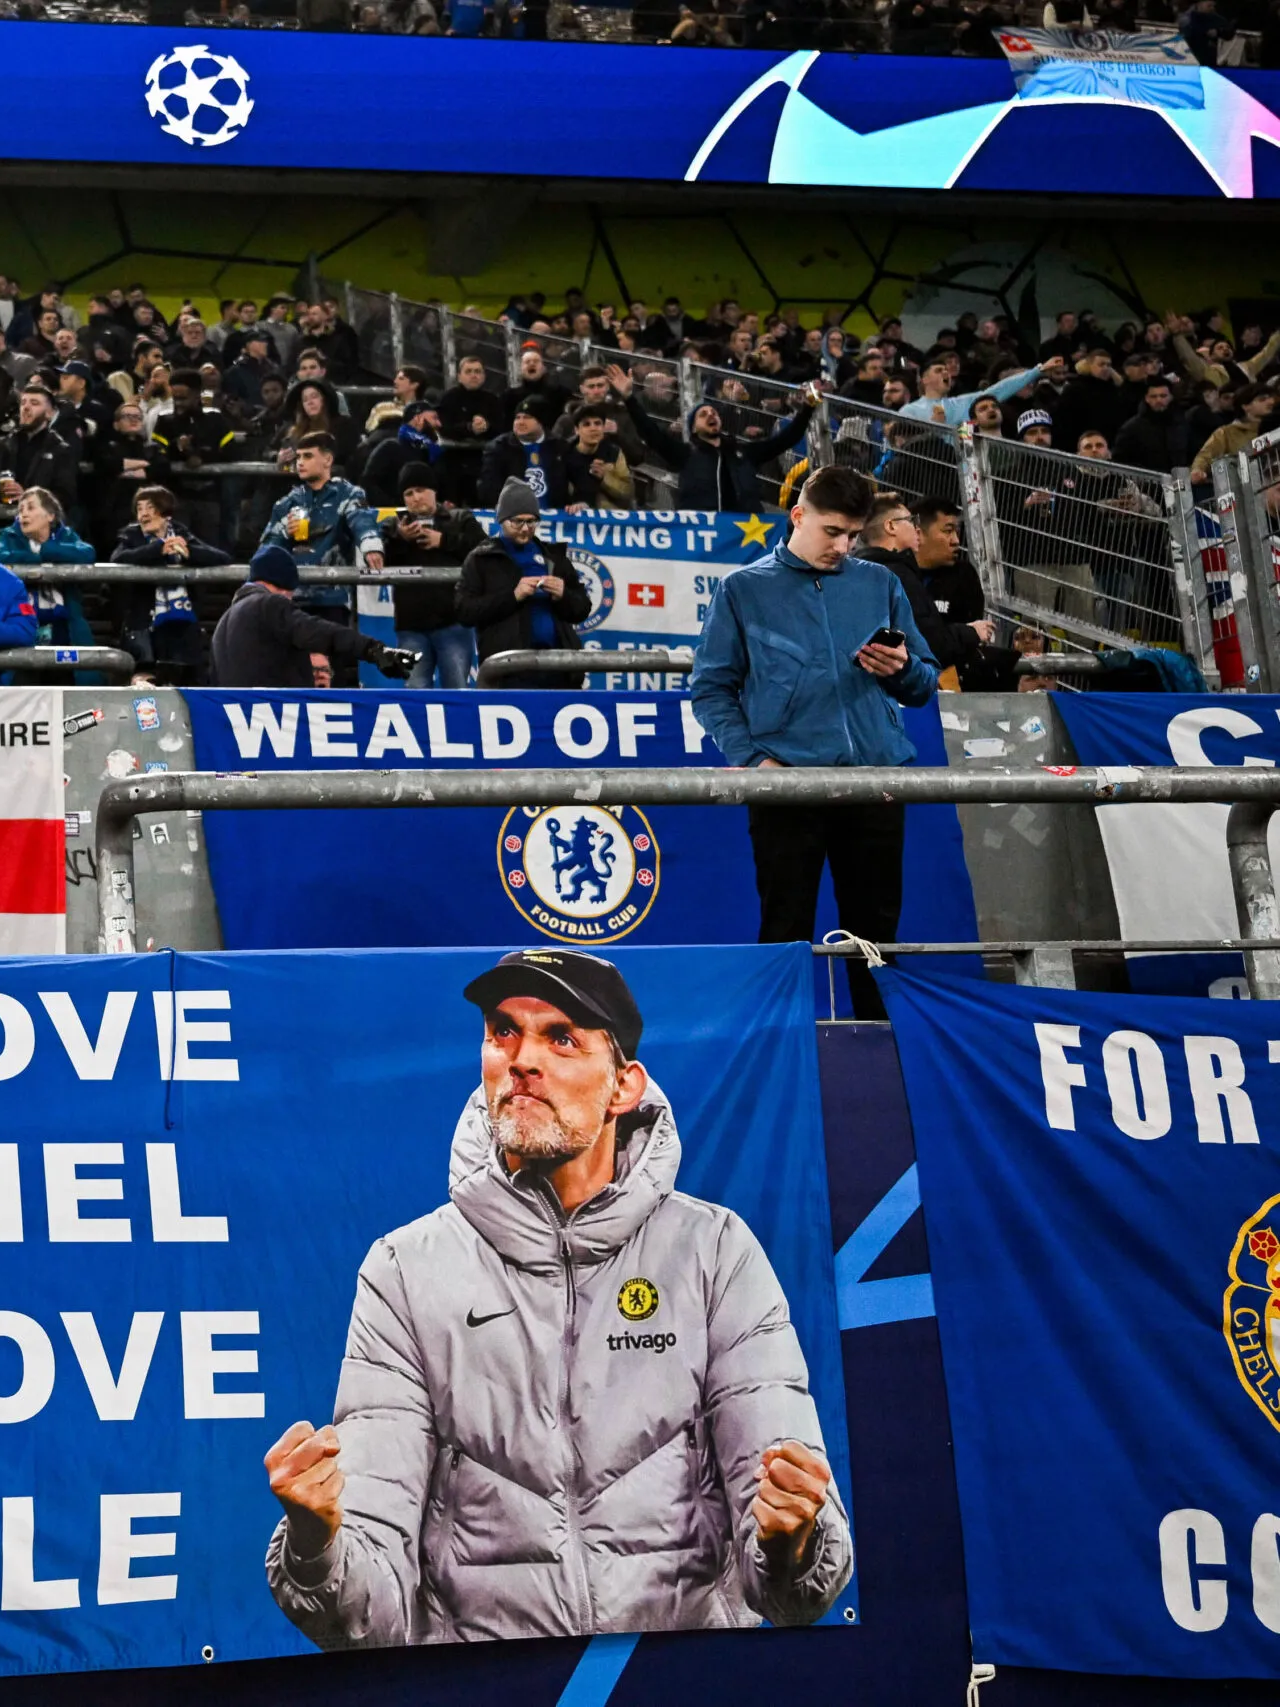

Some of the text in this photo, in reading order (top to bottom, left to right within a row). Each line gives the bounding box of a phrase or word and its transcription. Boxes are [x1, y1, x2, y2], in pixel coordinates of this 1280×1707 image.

[539, 520, 717, 552] ELIVING IT
[223, 703, 530, 759] WEALD
[554, 704, 657, 760] OF
[530, 903, 638, 936] FOOTBALL CLUB
[1032, 1022, 1280, 1144] FOR
[606, 1330, 677, 1354] trivago
